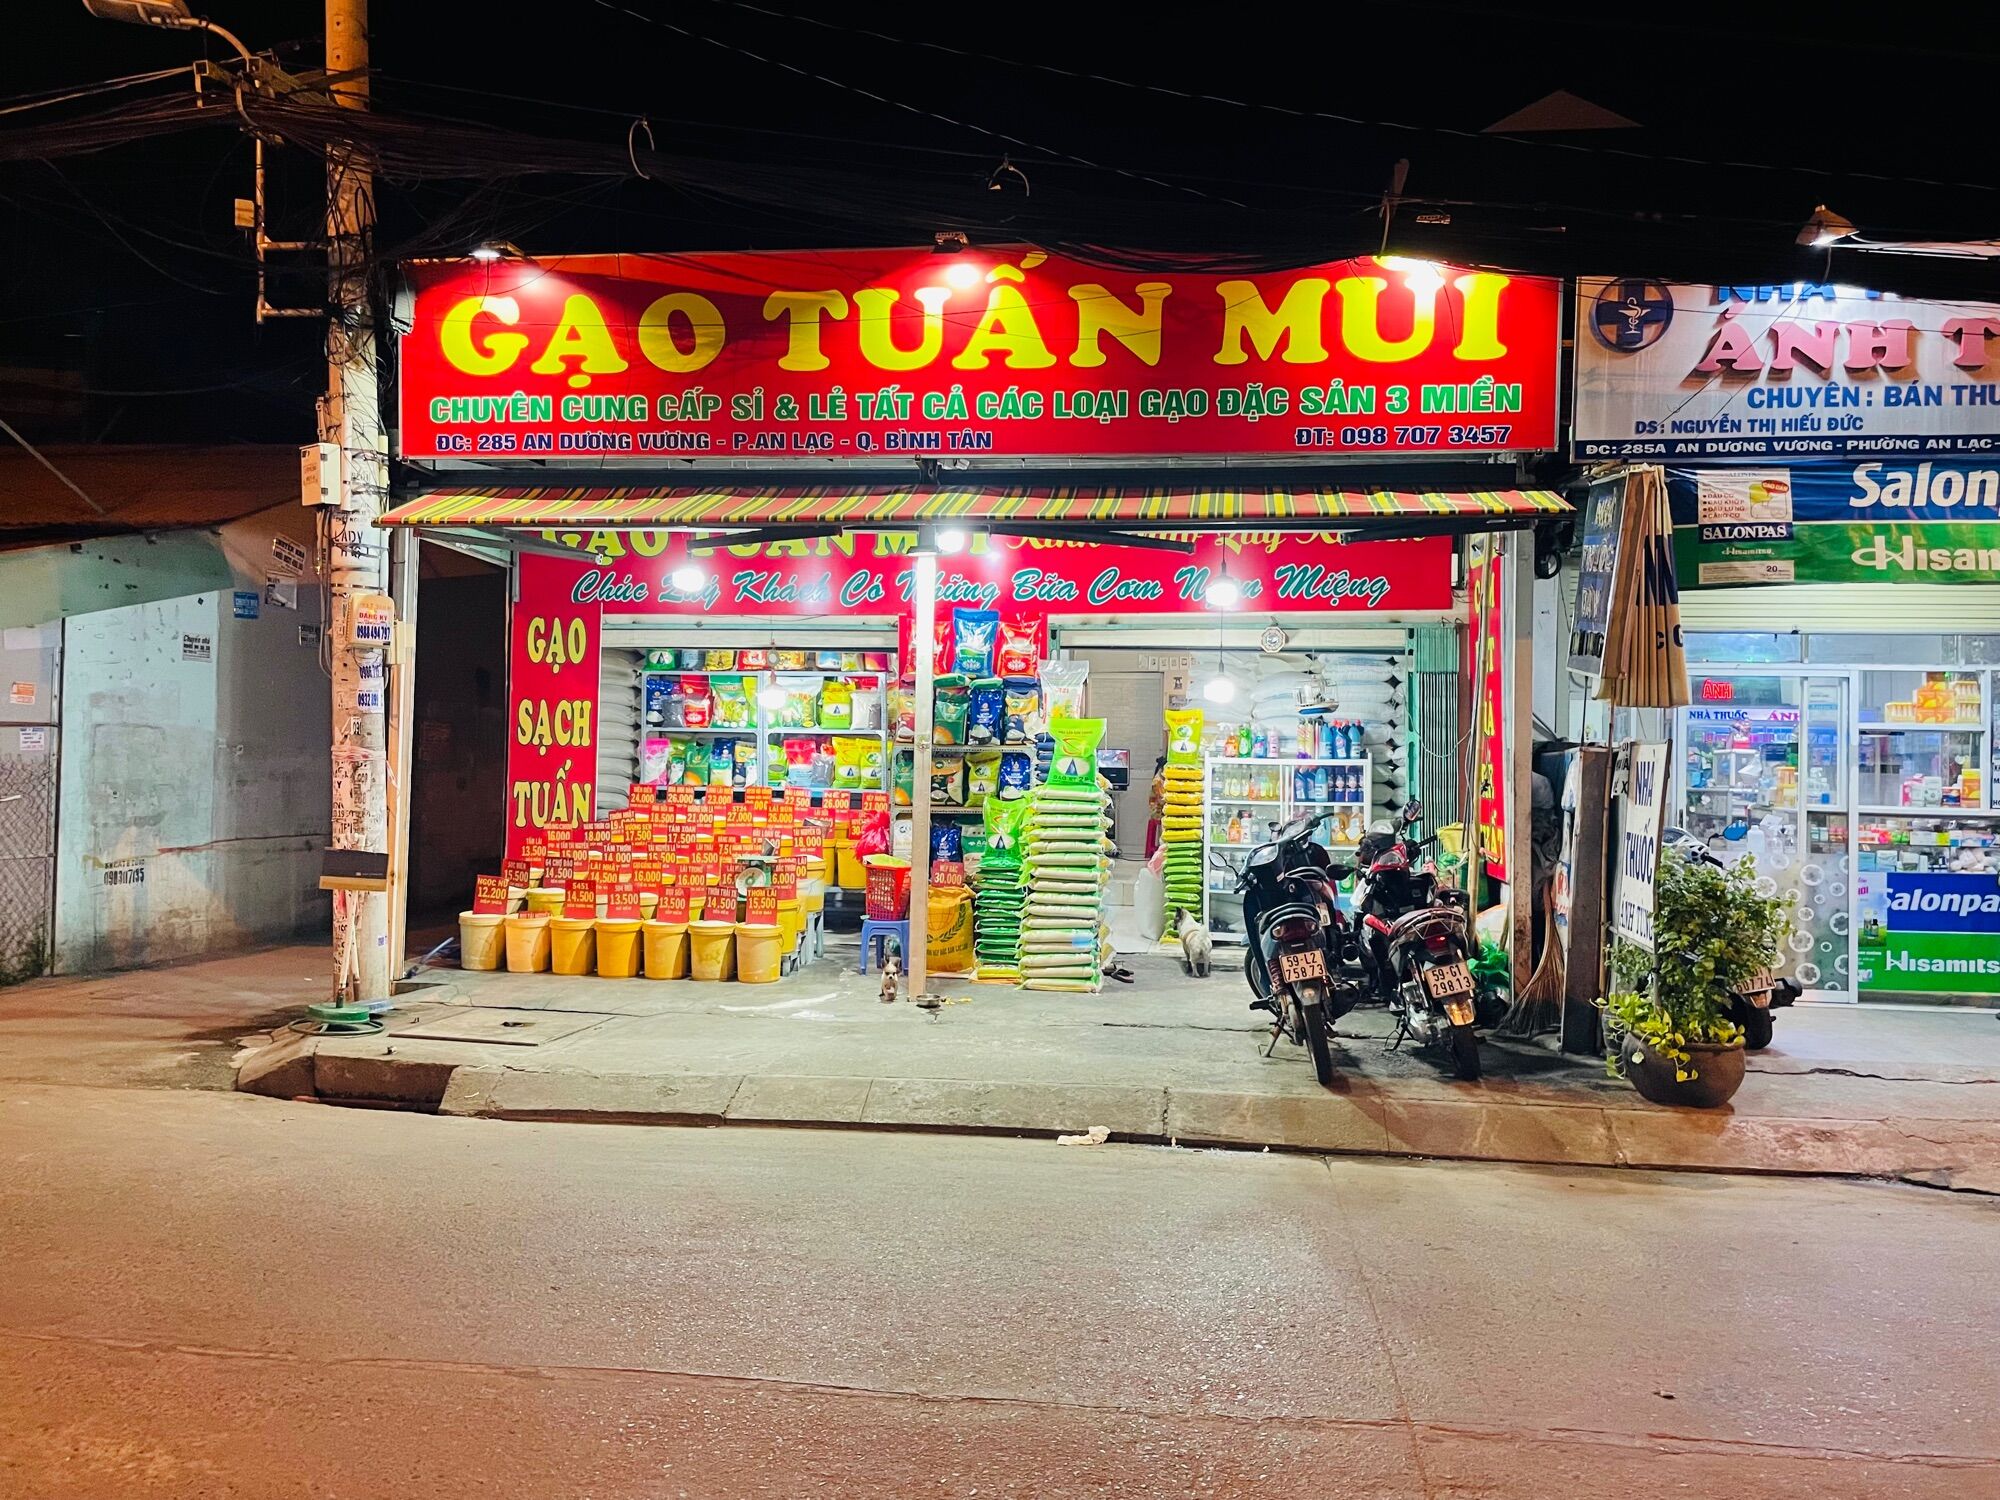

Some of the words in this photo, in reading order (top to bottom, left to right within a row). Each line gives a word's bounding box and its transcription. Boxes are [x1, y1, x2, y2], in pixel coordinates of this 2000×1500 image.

[440, 293, 726, 388] GẠO
[762, 251, 1173, 373] TUẤN
[1695, 302, 1914, 372] ÁNH
[430, 391, 552, 423] CHUYÊN
[561, 393, 649, 422] CUNG
[657, 384, 721, 422] CẤP
[730, 386, 764, 421] SỈ
[774, 393, 799, 421] &
[810, 386, 847, 420] LẺ
[856, 384, 915, 420] TẤT
[922, 386, 969, 420] CẢ
[976, 385, 1044, 419] CÁC
[1053, 389, 1129, 423] LOẠI
[1139, 388, 1207, 424] GẠO
[1216, 382, 1288, 424] ĐẶC
[1299, 377, 1376, 415] SẢN
[1386, 386, 1409, 415] 3
[1421, 374, 1523, 414] MIỀN
[1884, 380, 1943, 408] BÁN
[1635, 421, 1665, 435] DS:
[1670, 413, 1742, 434] NGUYỄN
[1747, 418, 1776, 437] THỊ
[1781, 413, 1822, 433] HIẾU
[1827, 413, 1864, 432] ĐỨC
[436, 434, 472, 452] ĐC:
[478, 434, 517, 451] 285
[523, 434, 553, 451] AN
[559, 431, 631, 451] DƯƠNG
[637, 431, 711, 451] VƯƠNG
[732, 433, 785, 451] P.AN
[791, 433, 834, 453] LẠC
[856, 433, 879, 451] Q.
[885, 427, 940, 450] BÌNH
[946, 427, 993, 450] TÂN
[1295, 427, 1334, 447] ĐT:
[1341, 427, 1387, 446] 098
[1396, 427, 1441, 445] 707
[1448, 426, 1512, 445] 3457
[1586, 444, 1617, 456] ĐC:
[1620, 444, 1667, 456] 285A
[1674, 442, 1702, 454] AN
[1705, 440, 1767, 453] DƯƠNG
[1773, 439, 1833, 452] VƯƠNG
[1846, 436, 1920, 451] PHƯỜNG
[1926, 439, 1952, 450] AN
[1957, 438, 1991, 453] LẠC
[1703, 525, 1788, 540] SALONPAS
[1766, 565, 1778, 573] 20
[571, 569, 649, 604] Chúc
[732, 570, 832, 604] Khách
[840, 569, 885, 607] Có
[1011, 567, 1080, 602] Bữa
[1088, 567, 1164, 606] Cơm
[1174, 565, 1264, 606] Nn
[1275, 563, 1391, 608] Miệng
[526, 616, 587, 674] GẠO
[516, 699, 592, 757] SẠCH
[513, 759, 592, 829] TUẤN
[625, 831, 652, 841] 17.500
[668, 833, 696, 844] 17.500
[794, 837, 822, 847] 18.000
[692, 853, 718, 863] 16.500
[545, 867, 573, 878] 14.500
[634, 871, 661, 882] 16.000
[678, 874, 705, 885] 16.000
[934, 872, 962, 885] 30.000
[477, 887, 507, 899] 12.200
[567, 891, 594, 902] 14.500
[609, 894, 639, 905] 13.500
[659, 896, 686, 909] 13.500
[707, 896, 736, 910] 14.500
[748, 897, 776, 908] 15.500
[1286, 952, 1317, 968] 59-L2
[1284, 964, 1324, 980] 758.73
[1431, 963, 1462, 982] 59-G1
[1432, 977, 1472, 996] 298.13
